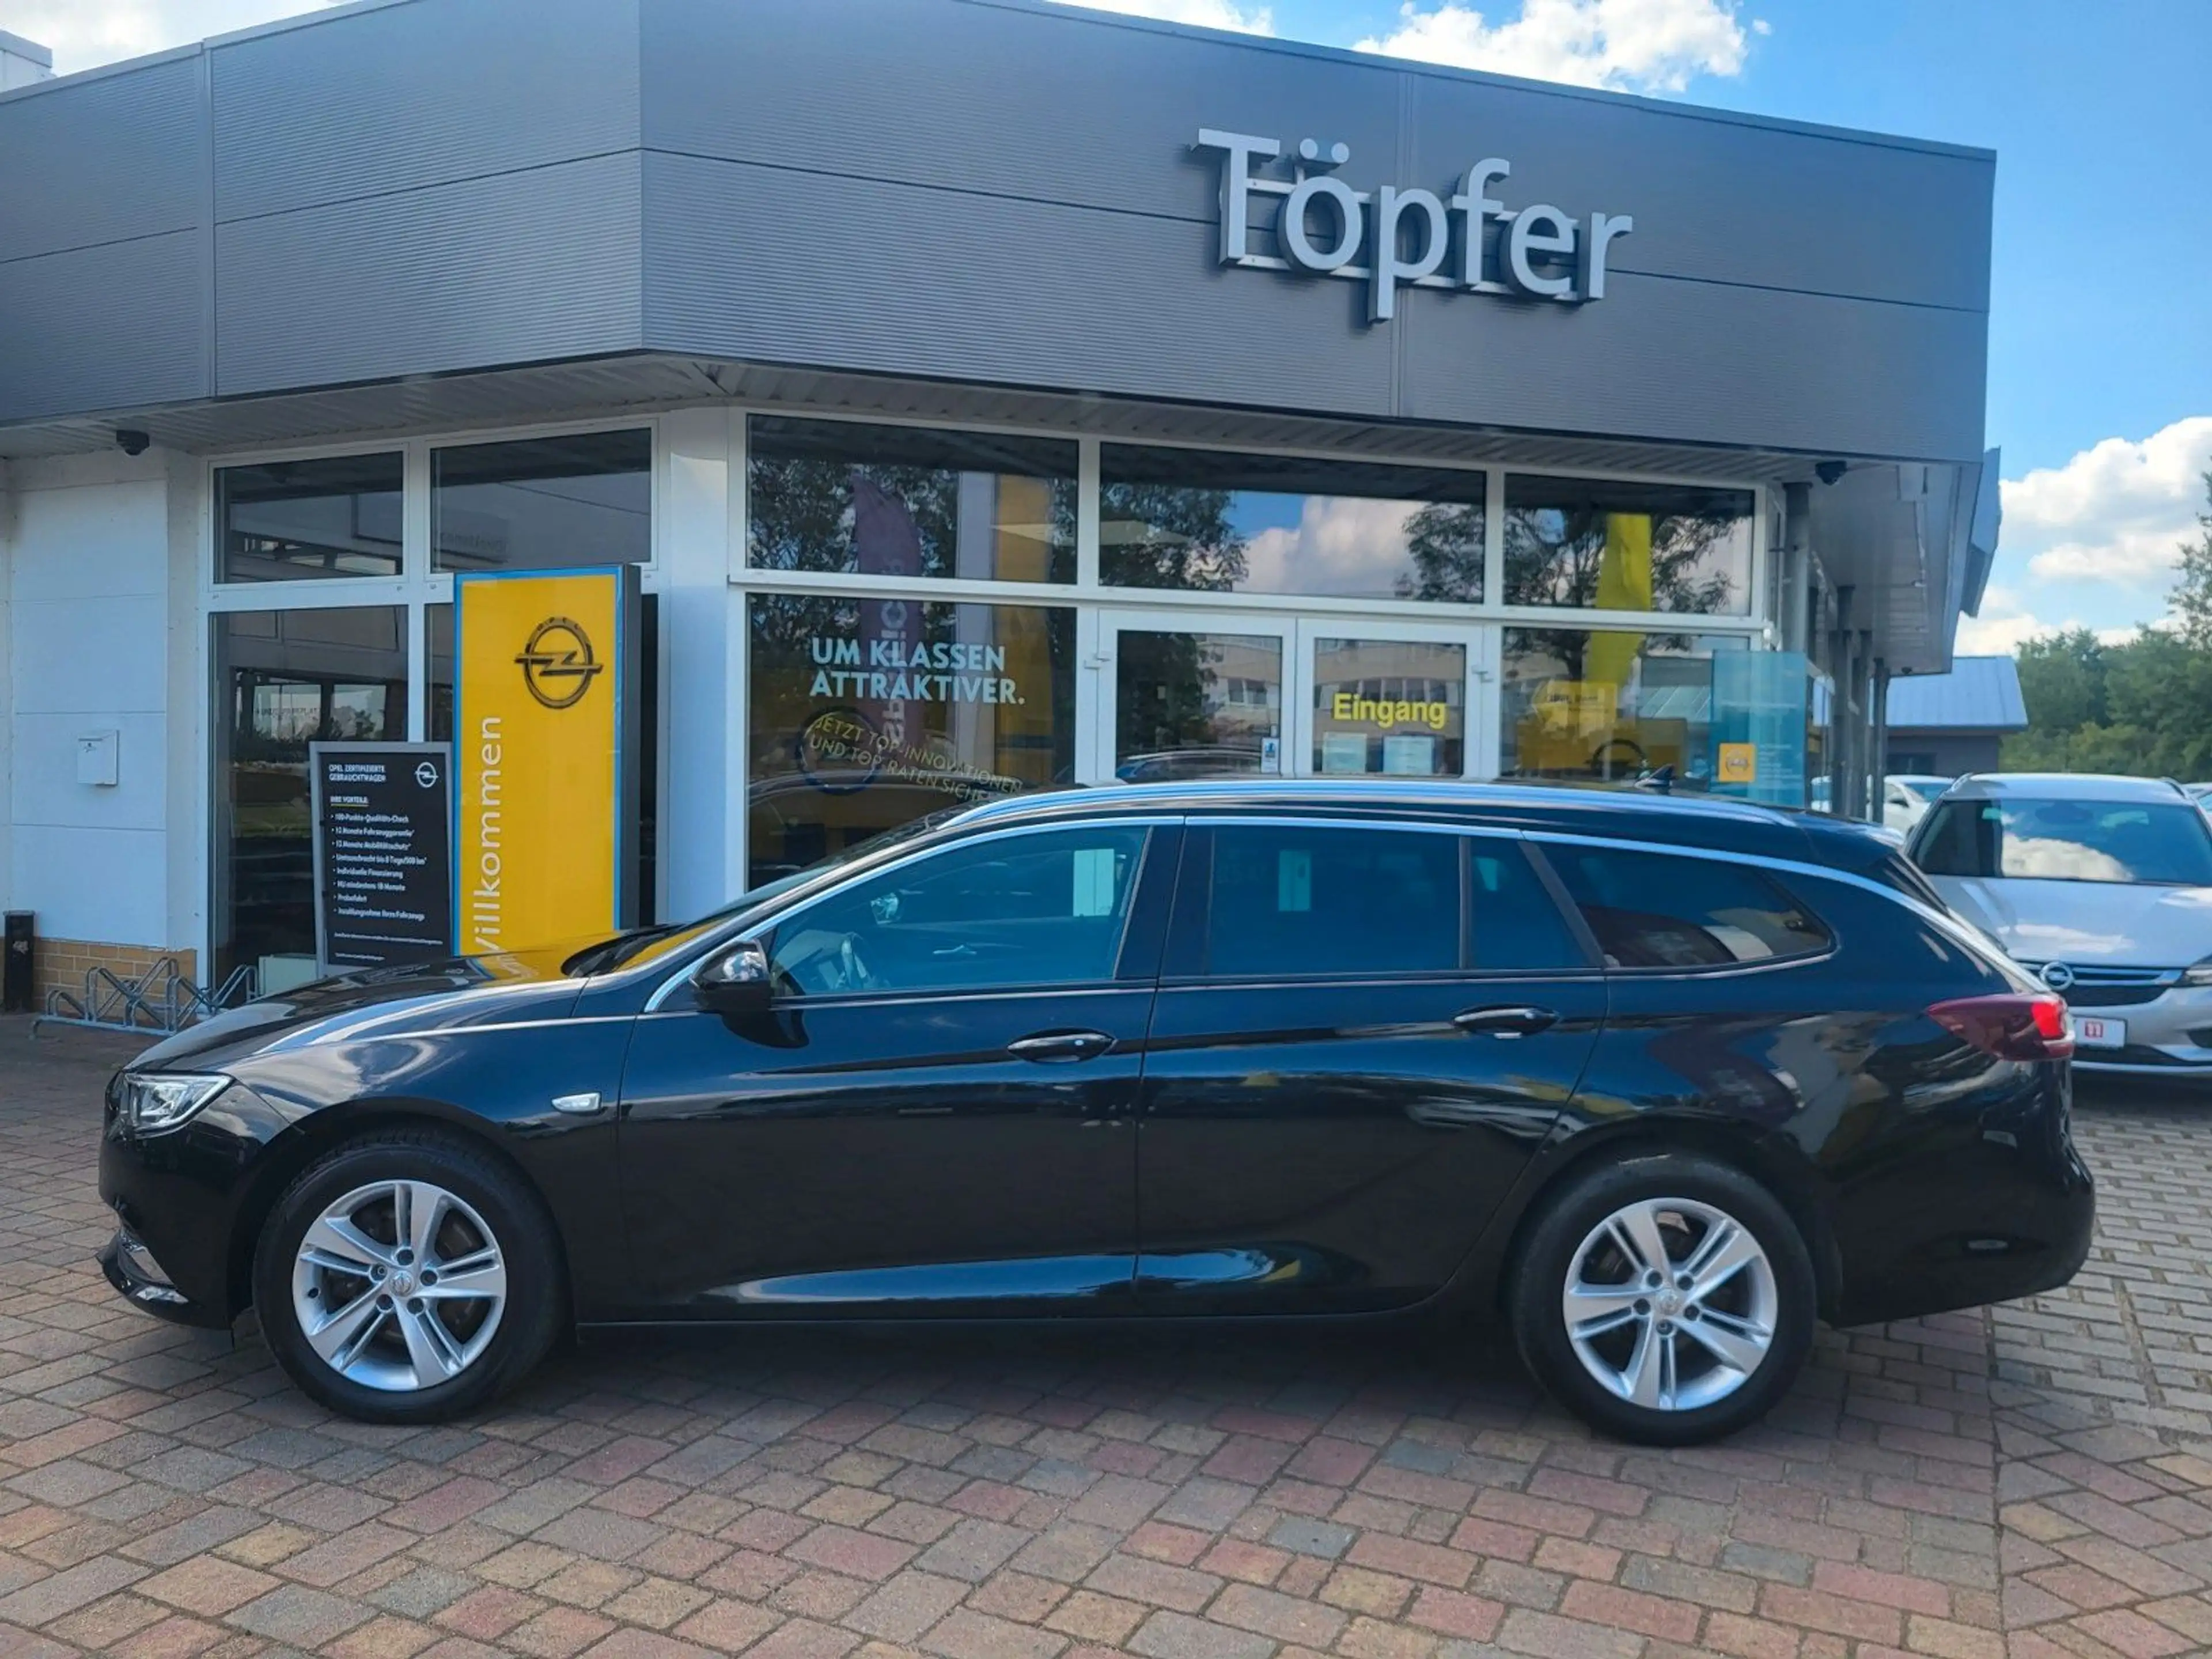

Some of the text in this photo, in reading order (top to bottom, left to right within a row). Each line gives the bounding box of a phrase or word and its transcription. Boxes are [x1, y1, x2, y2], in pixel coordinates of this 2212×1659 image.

[1197, 128, 1633, 320] Töpfer
[812, 637, 1005, 672] UM KLASSEN
[809, 669, 1026, 705] ATTRAKTIVER.
[814, 715, 865, 741] JETZT
[1332, 692, 1446, 729] Eingang
[810, 735, 846, 756] UND
